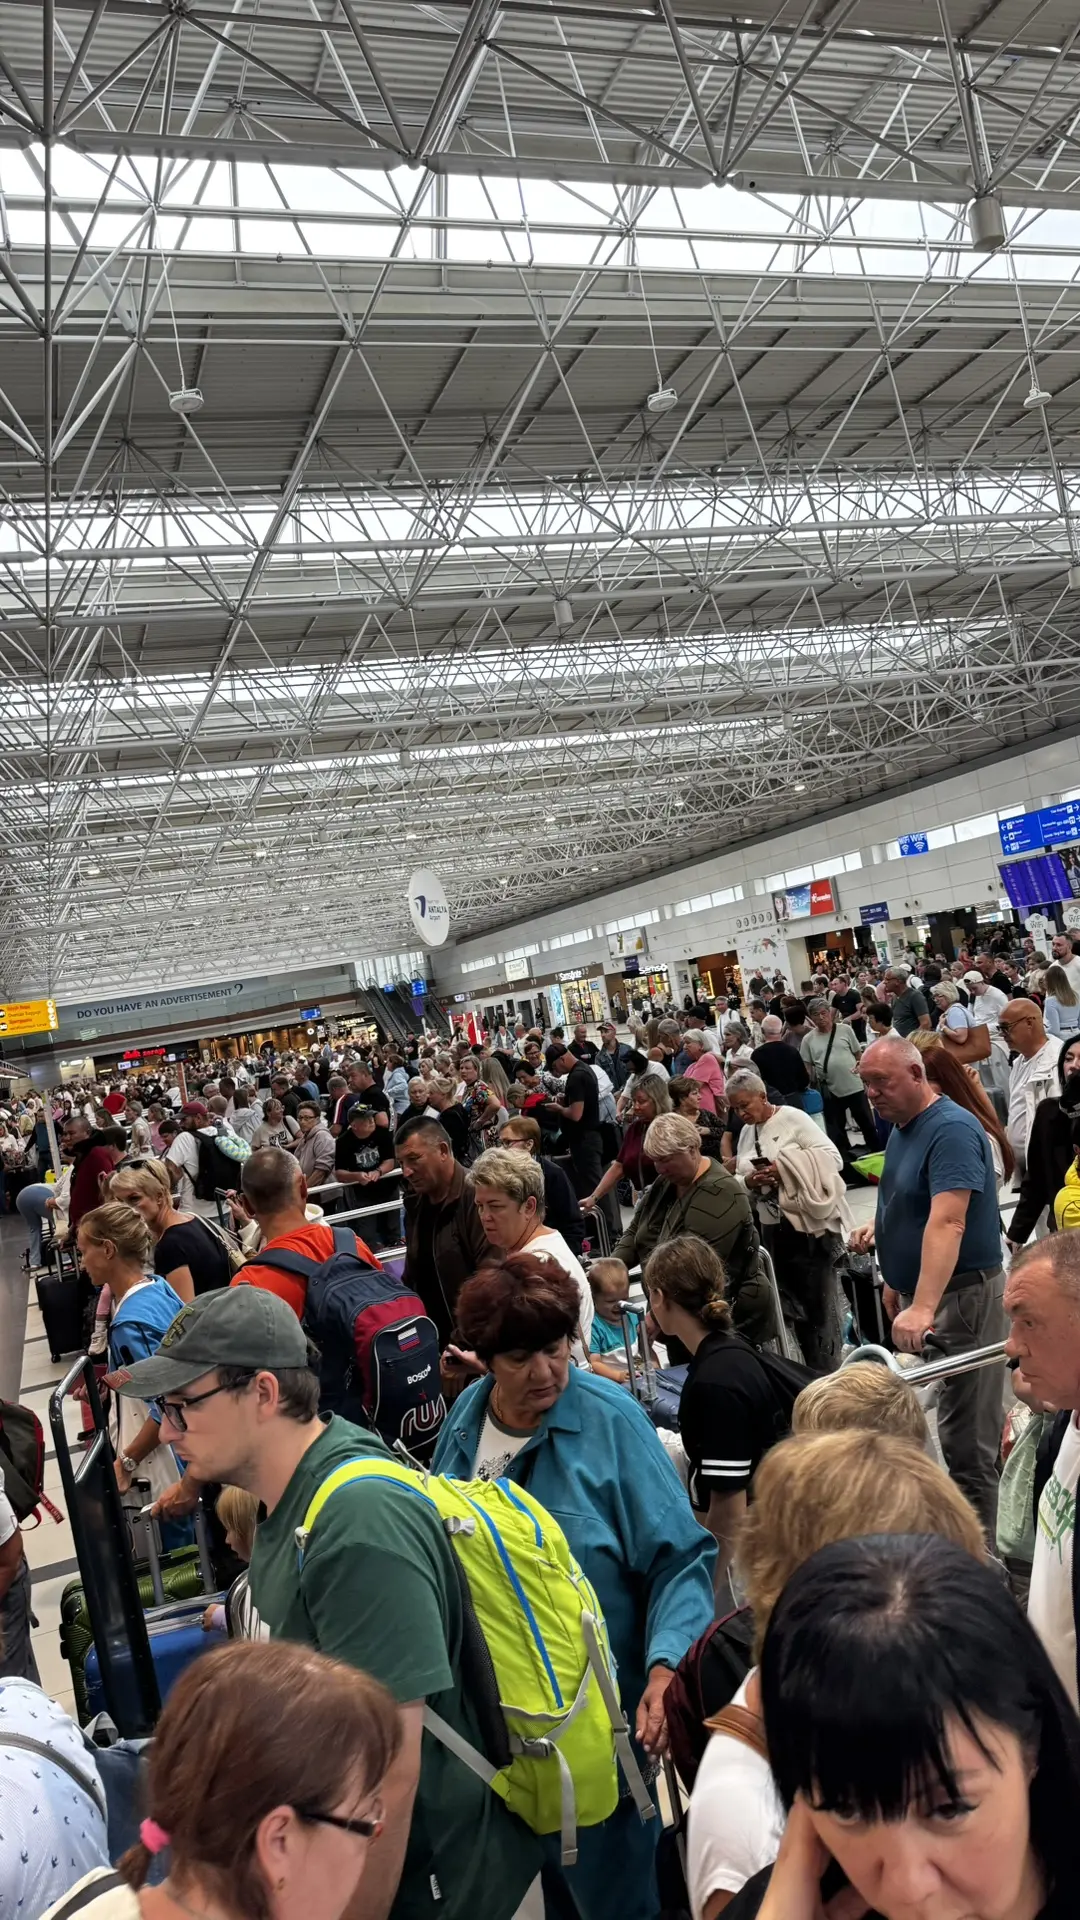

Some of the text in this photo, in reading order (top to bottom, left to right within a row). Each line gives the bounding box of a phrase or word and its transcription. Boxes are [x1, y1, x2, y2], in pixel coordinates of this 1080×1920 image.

[428, 905, 448, 914] ANTALYA
[77, 1010, 92, 1019] DO
[93, 1006, 115, 1017] YOU
[116, 1001, 143, 1013] HAVE
[145, 999, 159, 1009] AN
[160, 988, 232, 1007] ADVERTISEMENT
[407, 1368, 428, 1385] BOSCO
